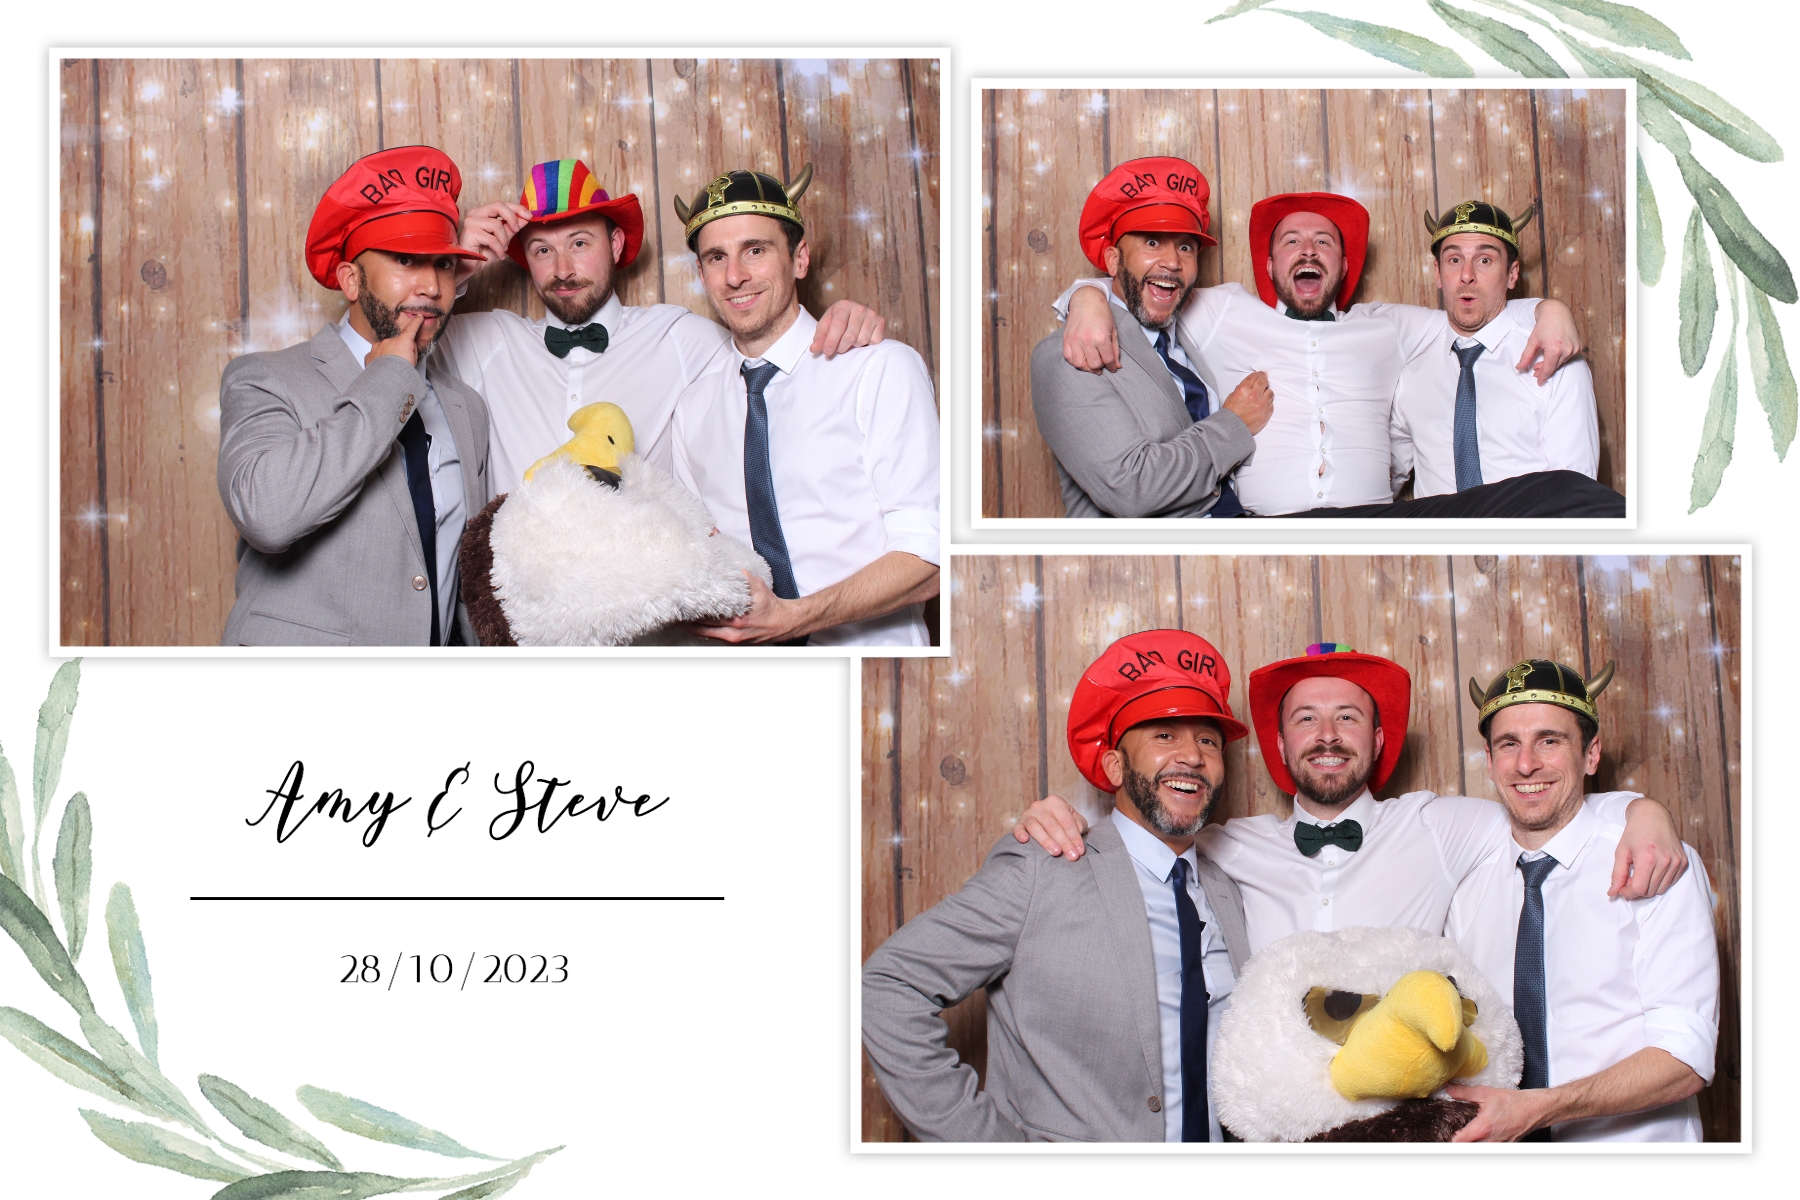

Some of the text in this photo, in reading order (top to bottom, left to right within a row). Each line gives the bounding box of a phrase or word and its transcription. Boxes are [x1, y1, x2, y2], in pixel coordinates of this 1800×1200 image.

[415, 166, 451, 193] GIR
[1166, 173, 1198, 197] GIR
[1177, 649, 1215, 677] GIR
